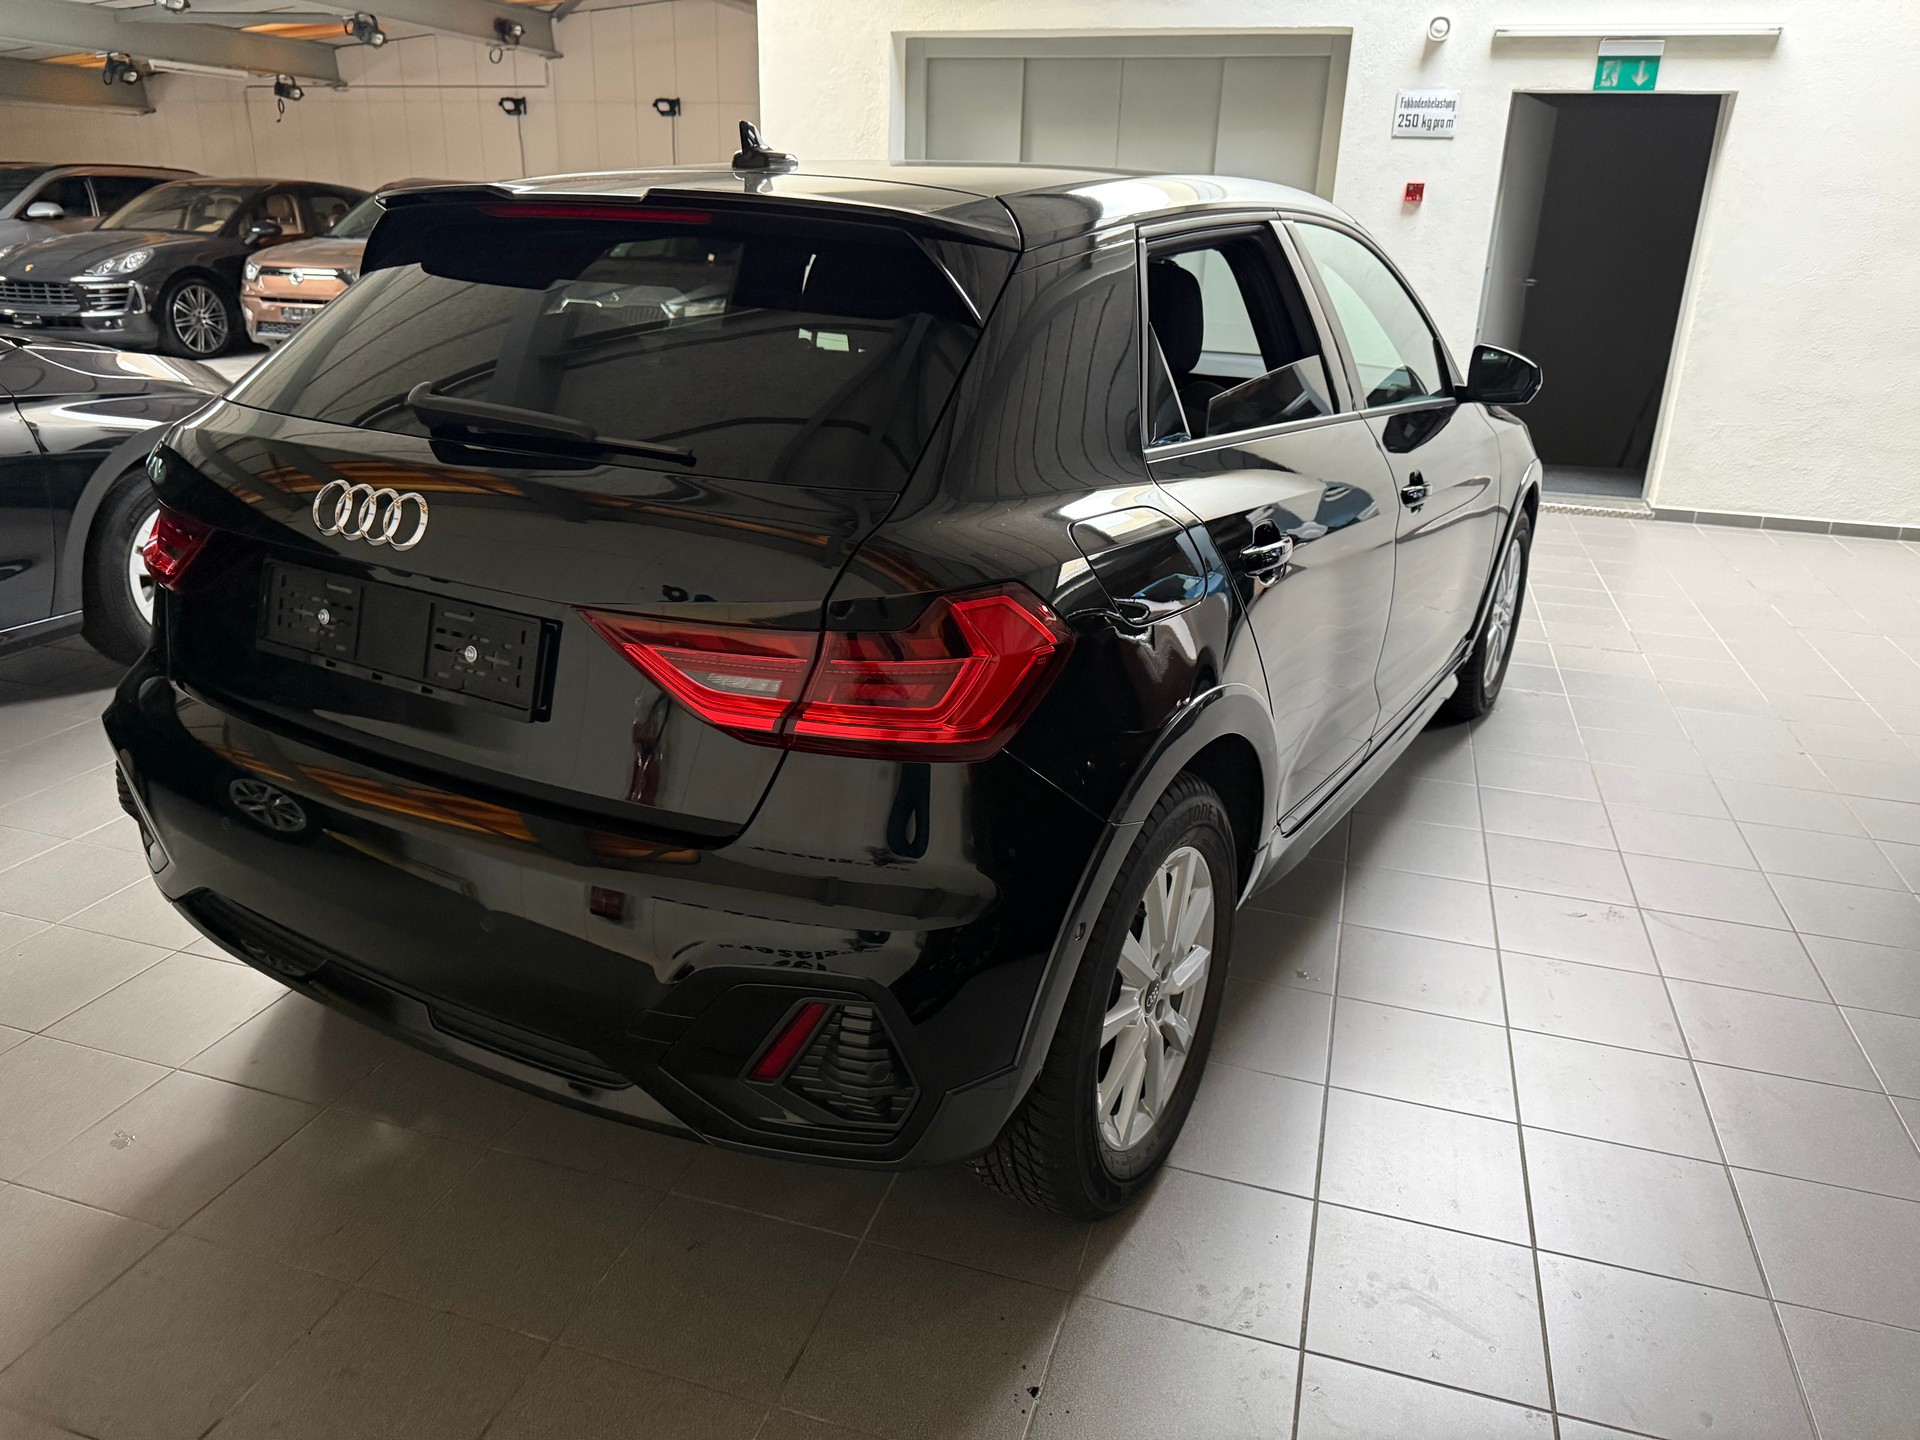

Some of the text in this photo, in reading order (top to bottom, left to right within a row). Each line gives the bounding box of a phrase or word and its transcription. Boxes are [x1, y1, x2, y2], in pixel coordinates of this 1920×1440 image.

[1398, 113, 1419, 128] 250
[1421, 114, 1432, 131] kg
[1432, 118, 1445, 131] pro
